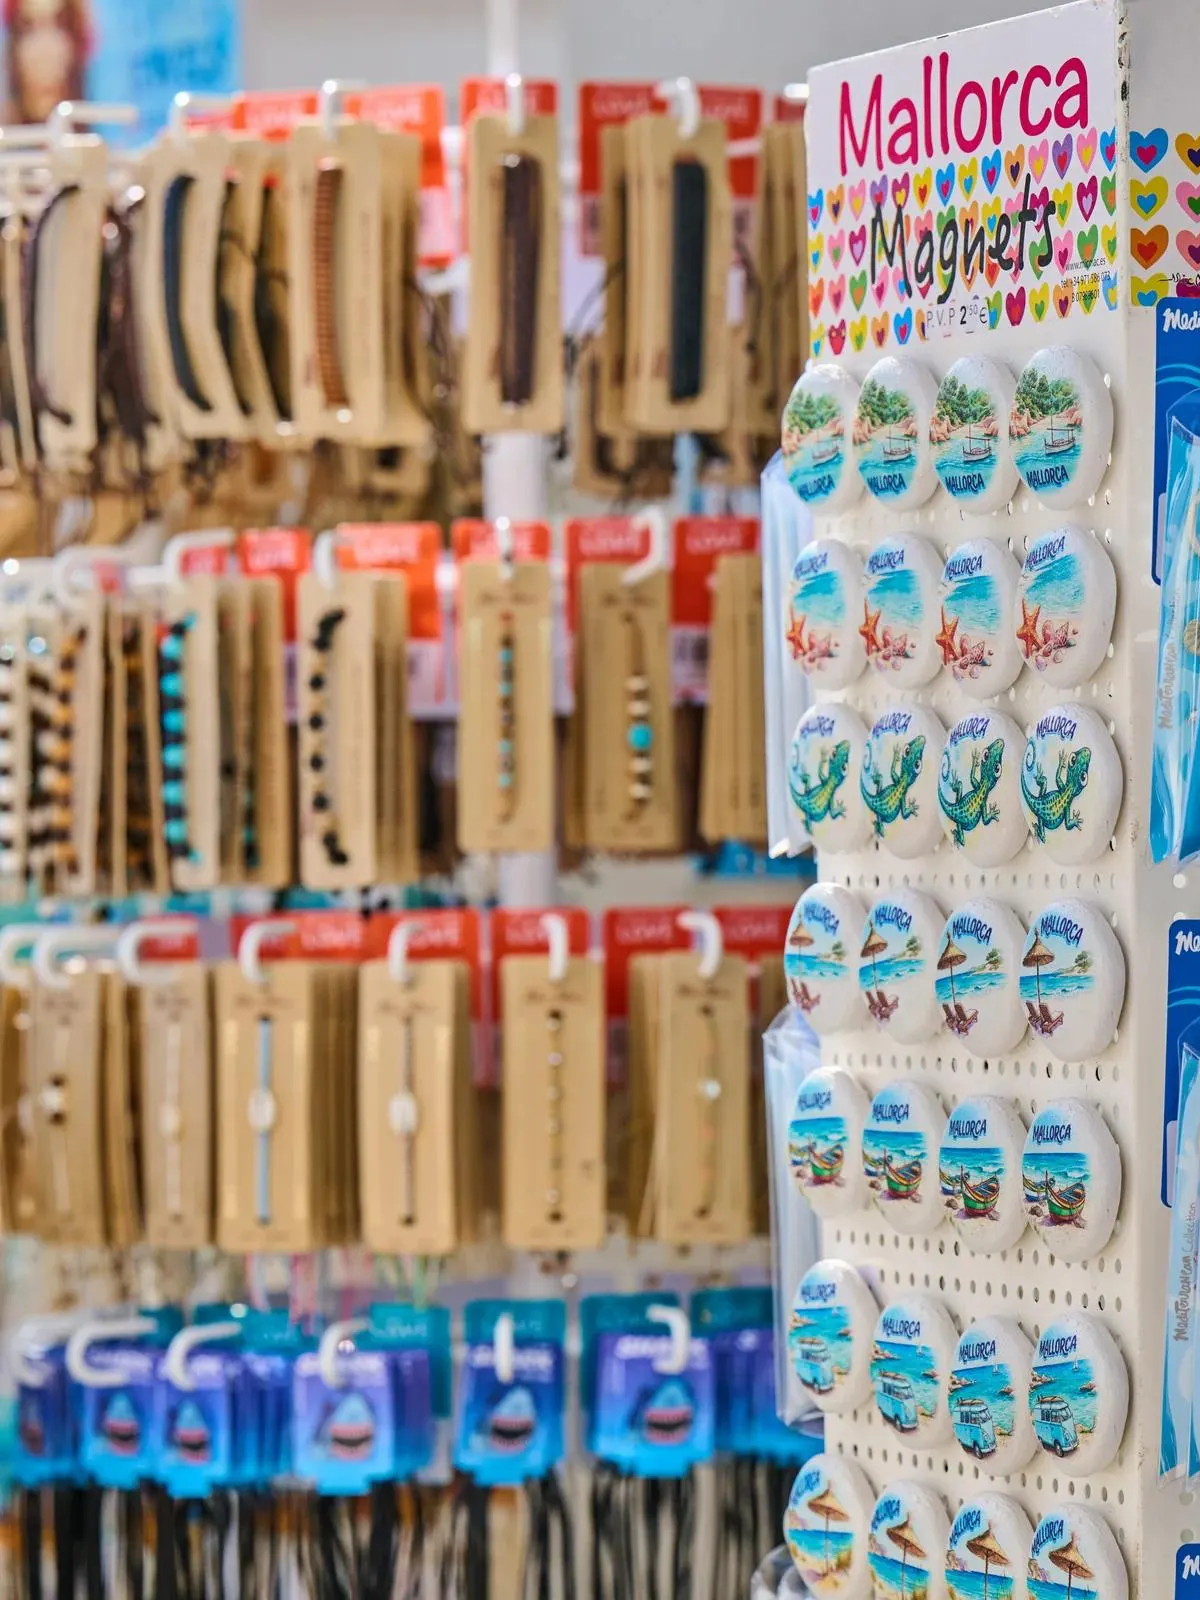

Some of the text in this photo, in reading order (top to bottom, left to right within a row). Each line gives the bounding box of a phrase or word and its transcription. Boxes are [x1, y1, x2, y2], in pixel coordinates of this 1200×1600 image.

[840, 52, 1088, 176] Mallorca
[871, 173, 1056, 304] Magnets
[867, 473, 907, 496] MALLORCA
[945, 472, 985, 496] MALLORCA
[1026, 464, 1069, 488] MALLORCA
[868, 549, 905, 574] MALLORCA
[1026, 536, 1066, 571] MALLORCA
[944, 554, 983, 579] MALLORCA
[872, 712, 911, 735] MALLORCA
[950, 717, 990, 742] MALLORCA
[1036, 717, 1078, 741] MALLORCA
[874, 904, 913, 933] MALLORCA
[952, 917, 993, 946] MALLORCA
[1040, 916, 1084, 948] MALLORCA
[872, 1104, 909, 1124] MALLORCA
[950, 1119, 987, 1141] MALLORCA
[1033, 1124, 1071, 1143] MALLORCA
[882, 1317, 921, 1338] MALLORCA
[959, 1339, 996, 1362] MALLORCA
[1039, 1334, 1077, 1359] MALLORCA
